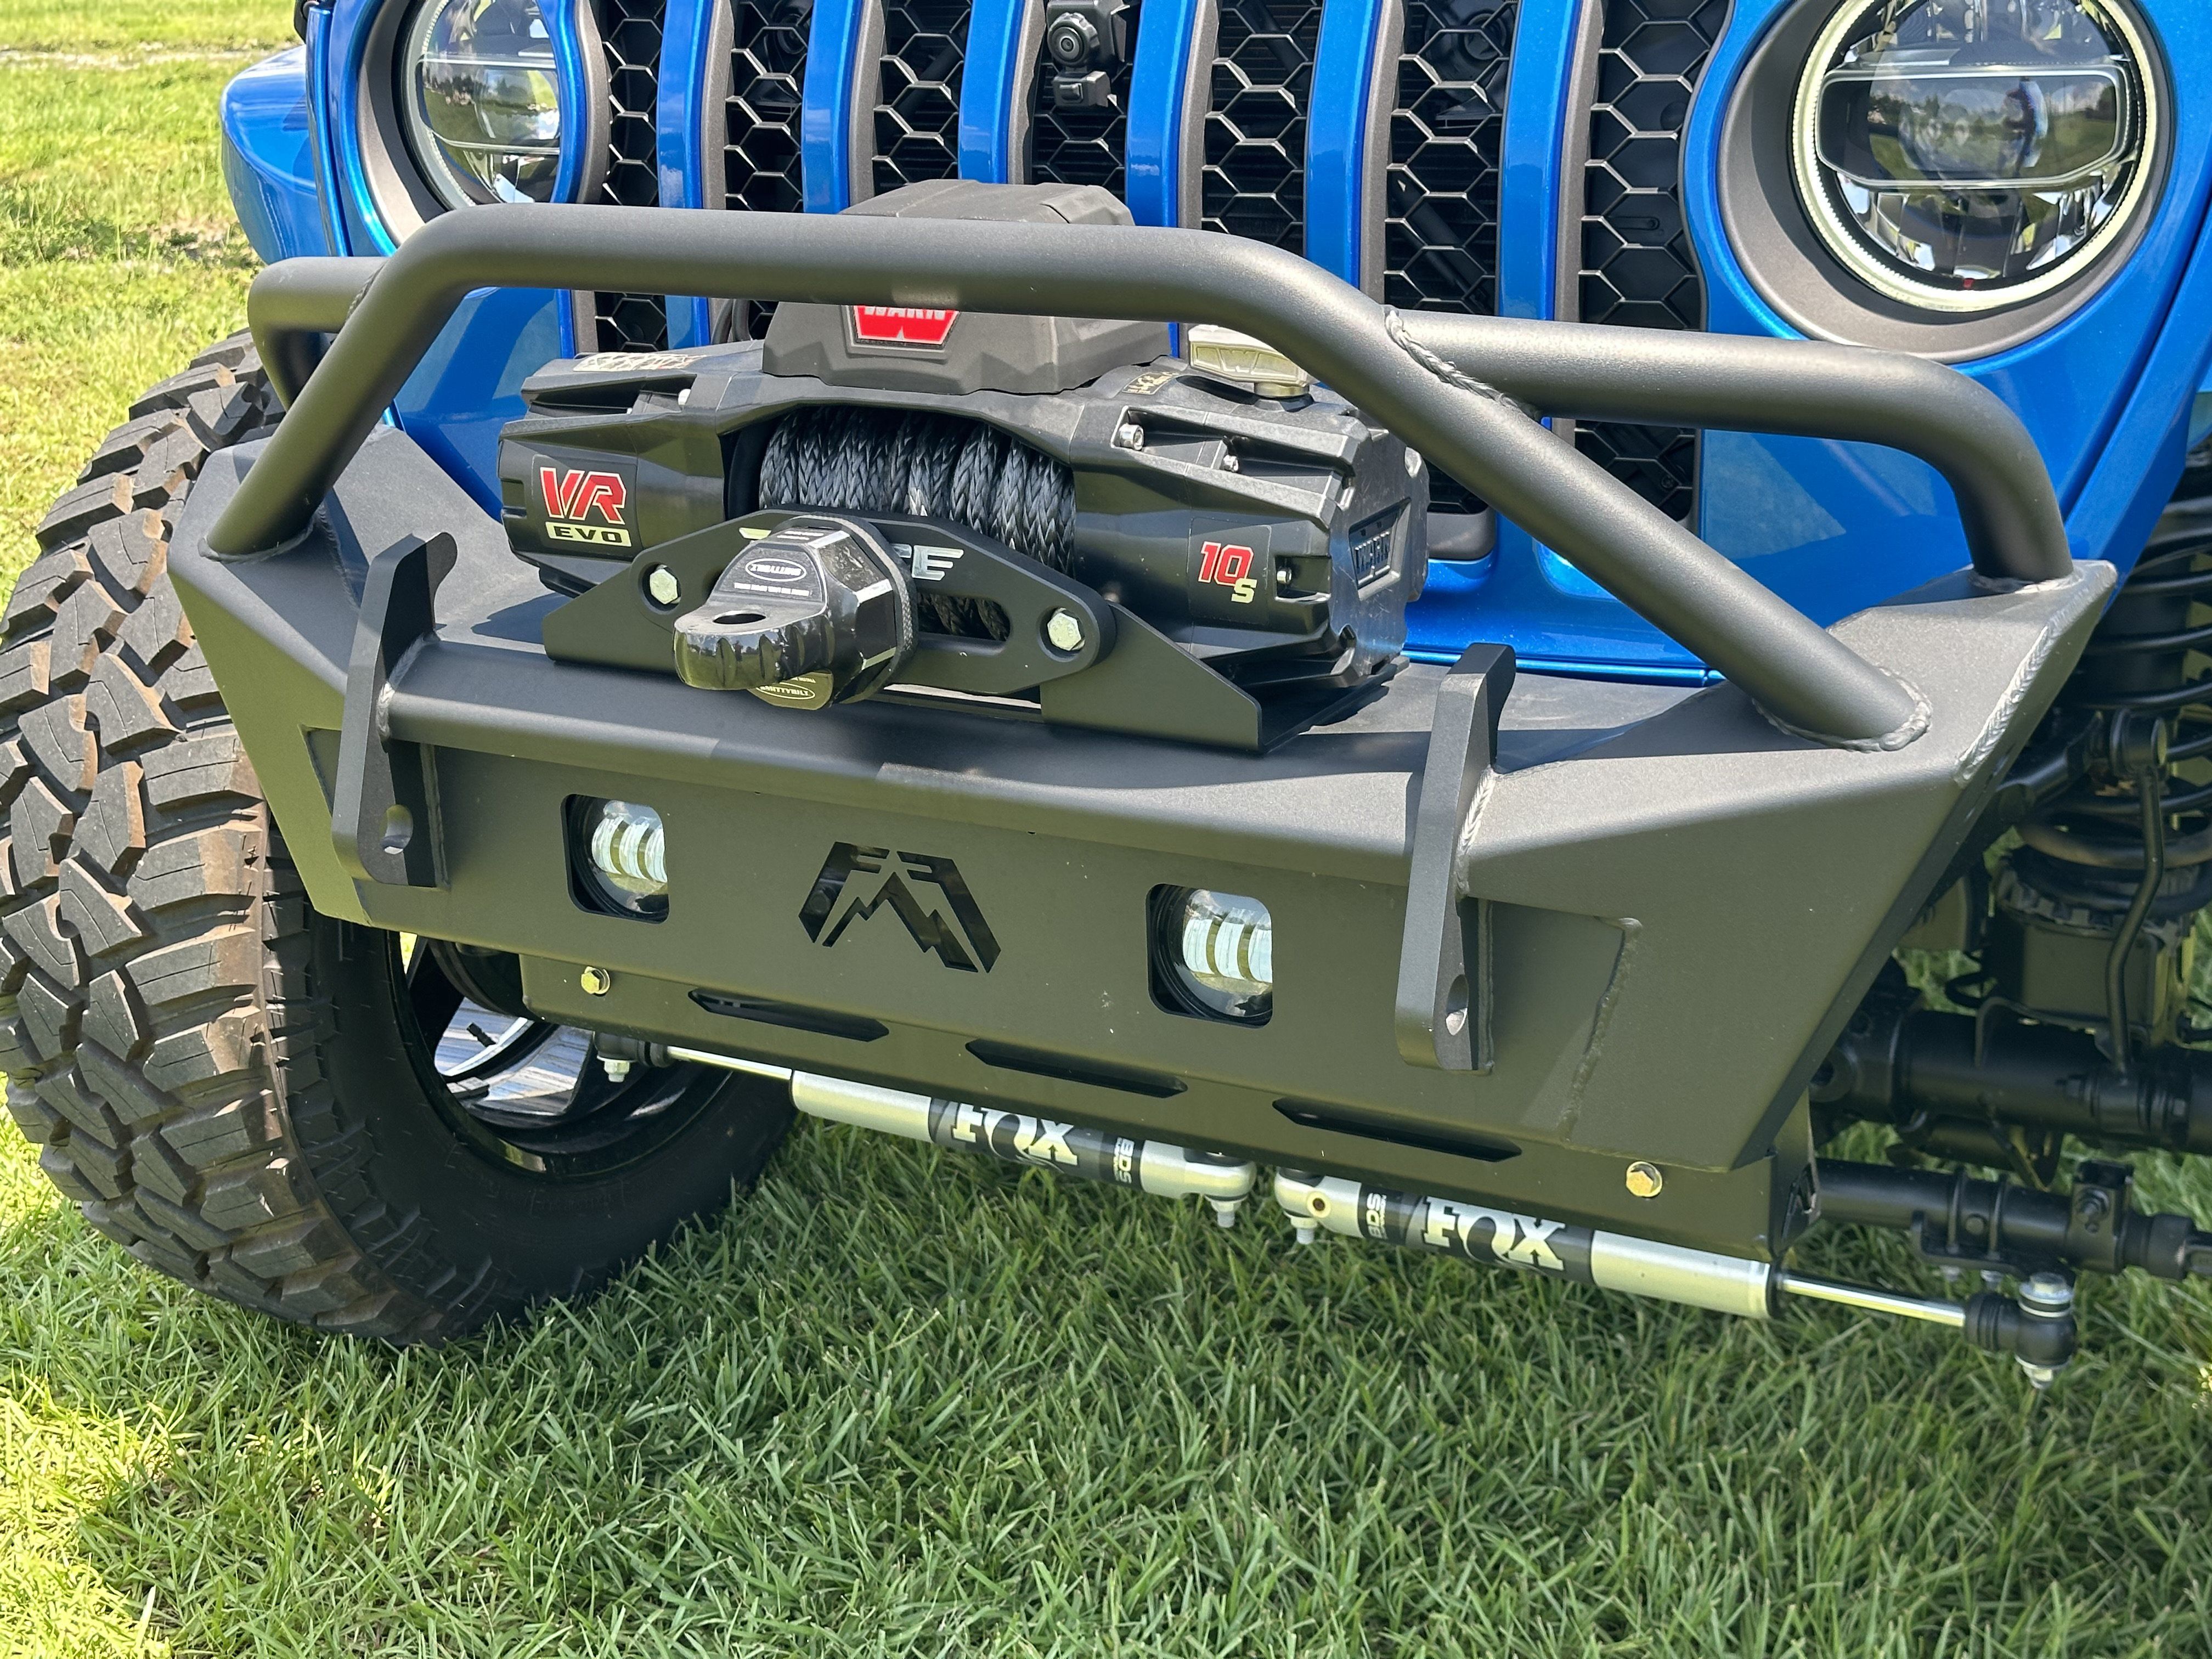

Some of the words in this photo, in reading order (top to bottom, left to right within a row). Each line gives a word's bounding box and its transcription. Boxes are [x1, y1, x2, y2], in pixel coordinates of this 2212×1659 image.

[540, 467, 627, 525] VR
[554, 526, 622, 543] EVO
[952, 1103, 1078, 1169] FOX
[1366, 1193, 1383, 1239] BDS
[1424, 1196, 1566, 1272] FOX
